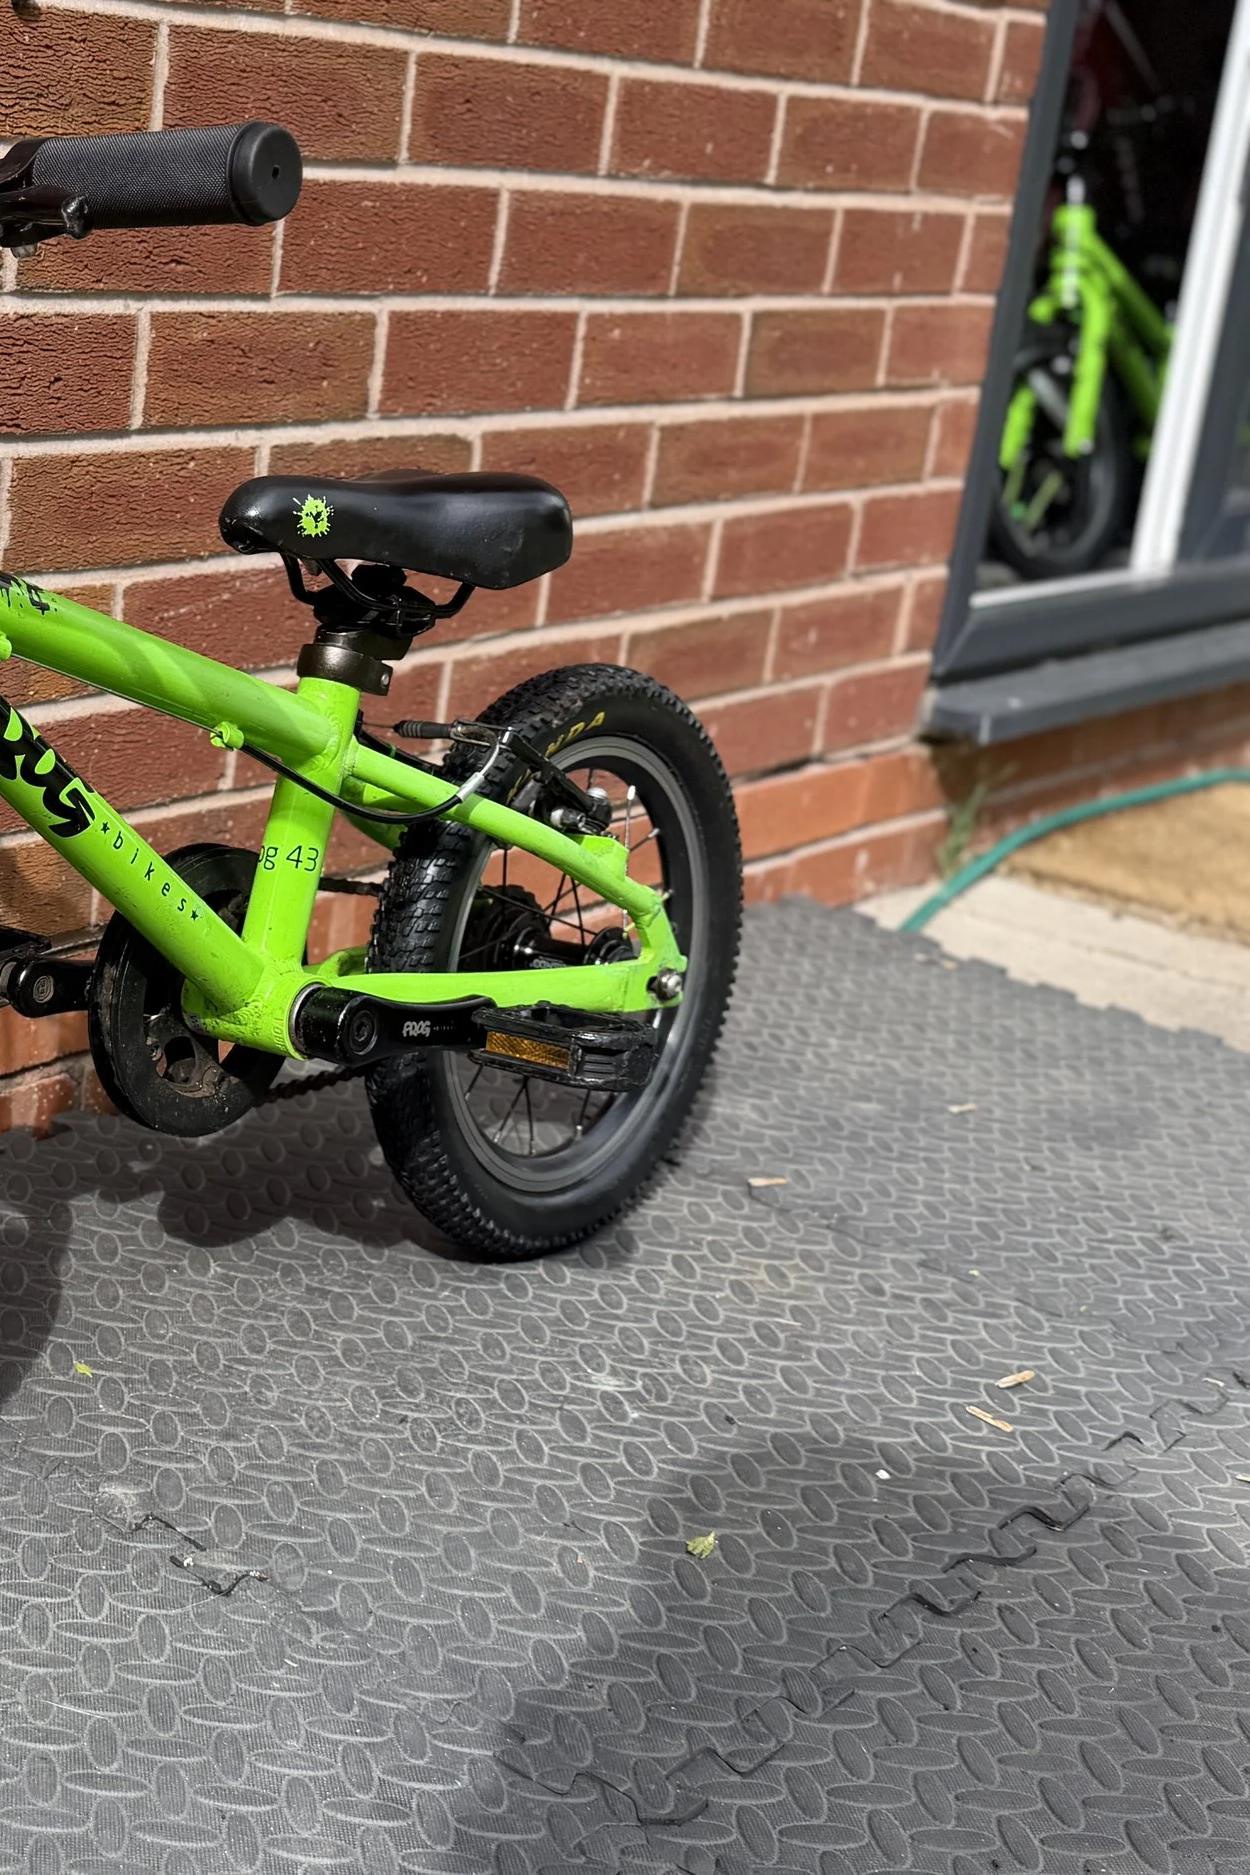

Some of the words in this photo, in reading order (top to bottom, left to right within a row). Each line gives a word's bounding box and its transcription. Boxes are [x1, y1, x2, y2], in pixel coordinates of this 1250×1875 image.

[112, 830, 187, 912] bikes
[286, 845, 319, 872] 43
[402, 1020, 431, 1037] FROG
